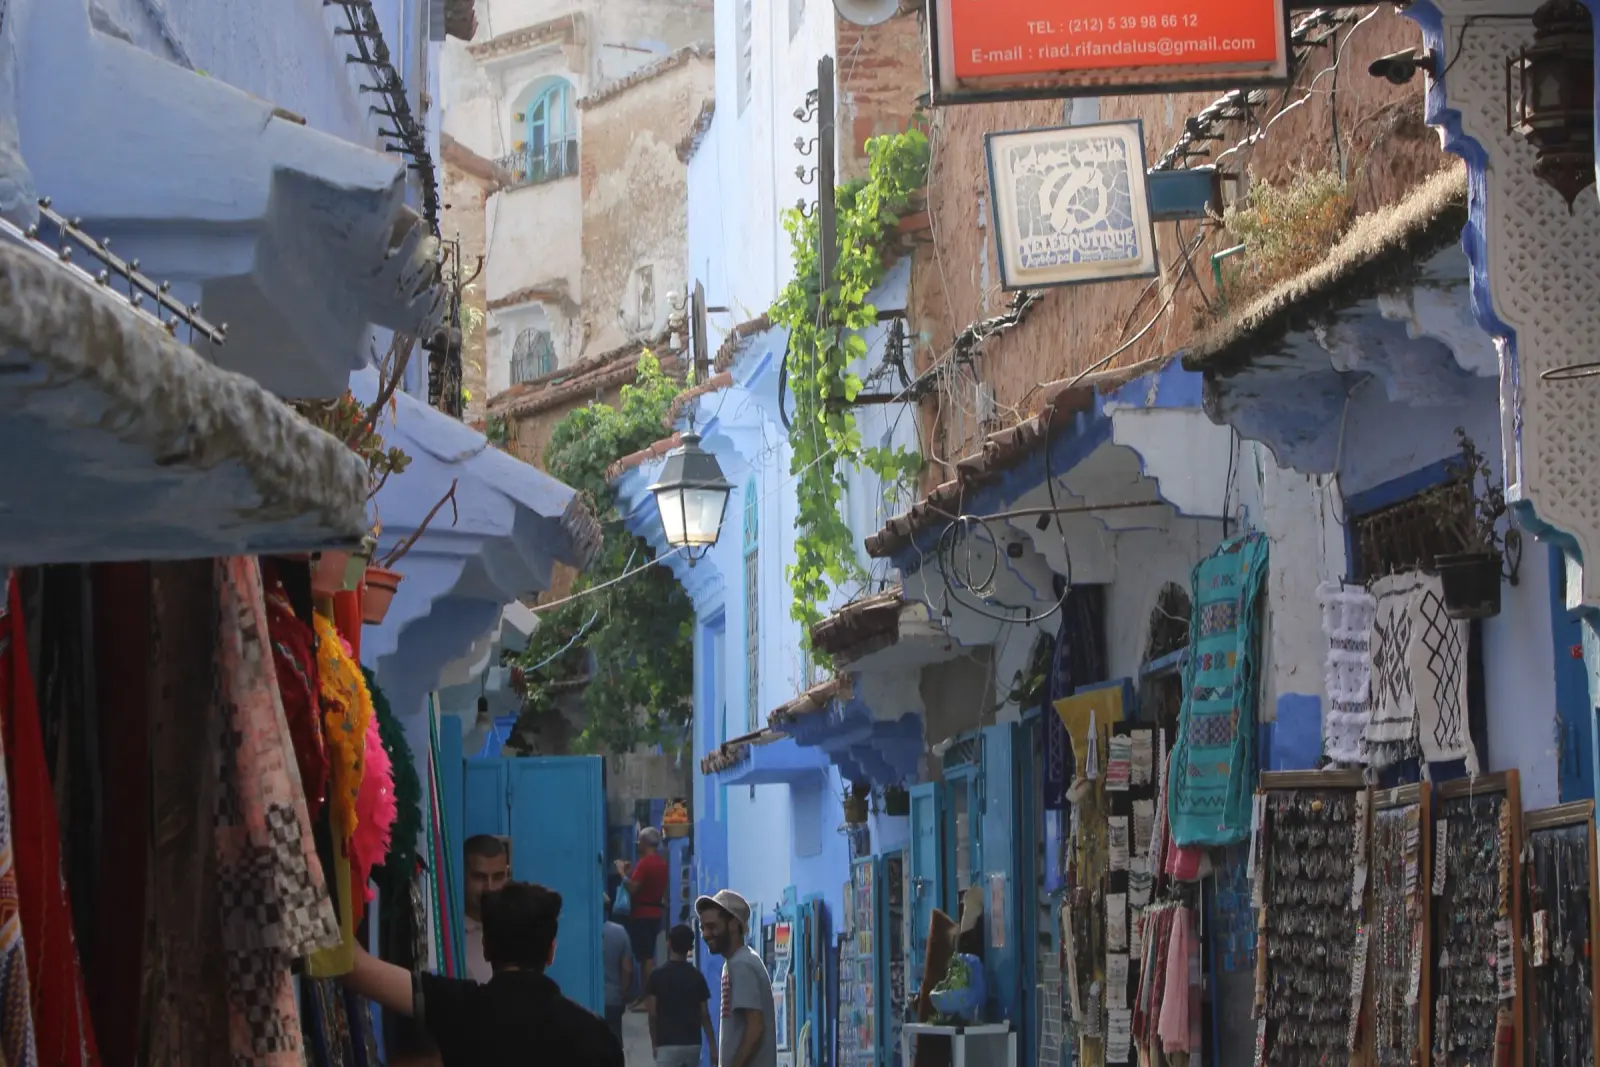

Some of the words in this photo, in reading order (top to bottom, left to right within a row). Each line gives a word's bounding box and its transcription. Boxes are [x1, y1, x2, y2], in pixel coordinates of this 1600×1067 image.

[1026, 20, 1055, 35] TEL
[1068, 17, 1103, 36] (212)
[1107, 16, 1116, 30] 5
[1120, 15, 1137, 30] 39
[1140, 14, 1157, 29] 98
[1161, 13, 1177, 28] 66
[1182, 13, 1198, 28] 12
[971, 45, 1023, 63] E-mail
